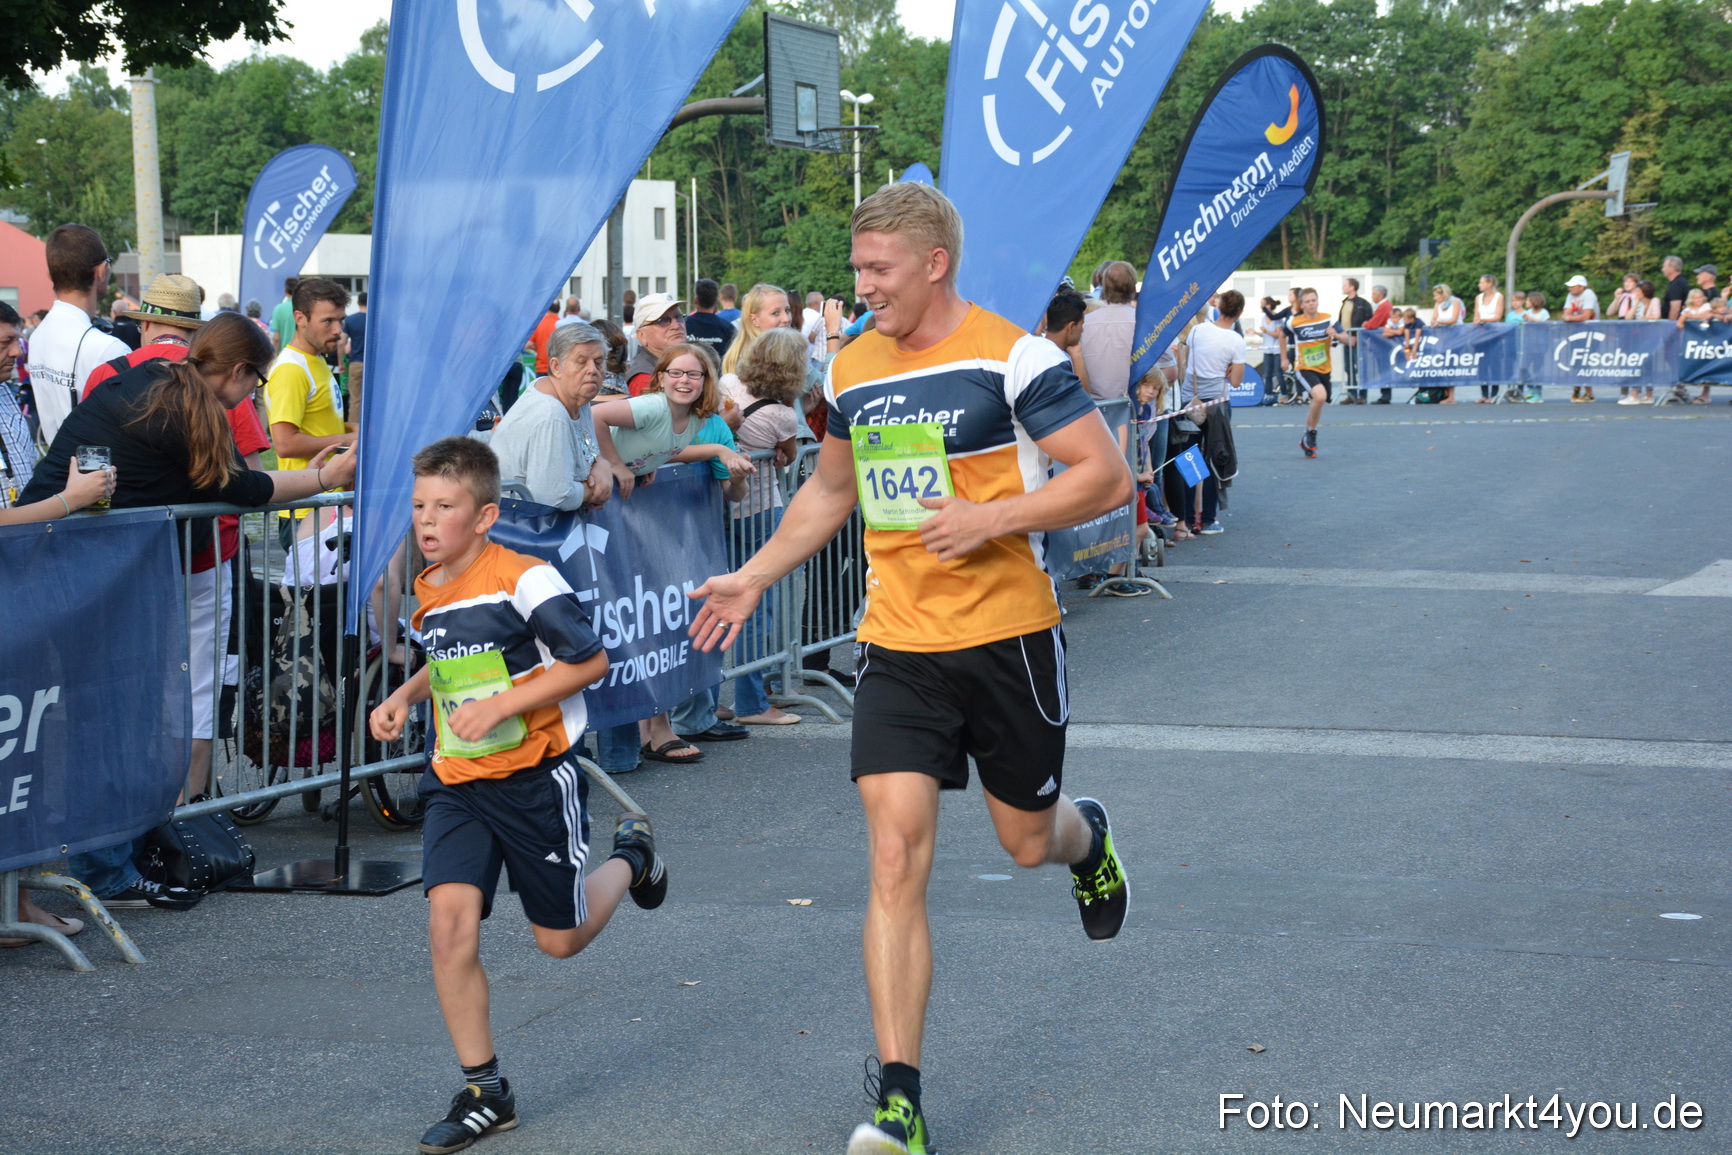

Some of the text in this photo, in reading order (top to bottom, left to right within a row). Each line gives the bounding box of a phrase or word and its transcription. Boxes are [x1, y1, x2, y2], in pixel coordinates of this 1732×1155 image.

[1091, 0, 1158, 109] AUTO
[1231, 192, 1260, 228] Druck
[1279, 133, 1315, 182] Medien
[269, 165, 332, 254] Fischer
[291, 182, 339, 253] AUTOMOBILE
[1157, 151, 1274, 281] Frischmann
[1405, 349, 1485, 369] Fischer
[1409, 368, 1479, 378] AUTOMOBILE
[1570, 348, 1649, 367] Fischer
[1577, 368, 1642, 377] AUTOMOBILE
[866, 466, 942, 500] 1642
